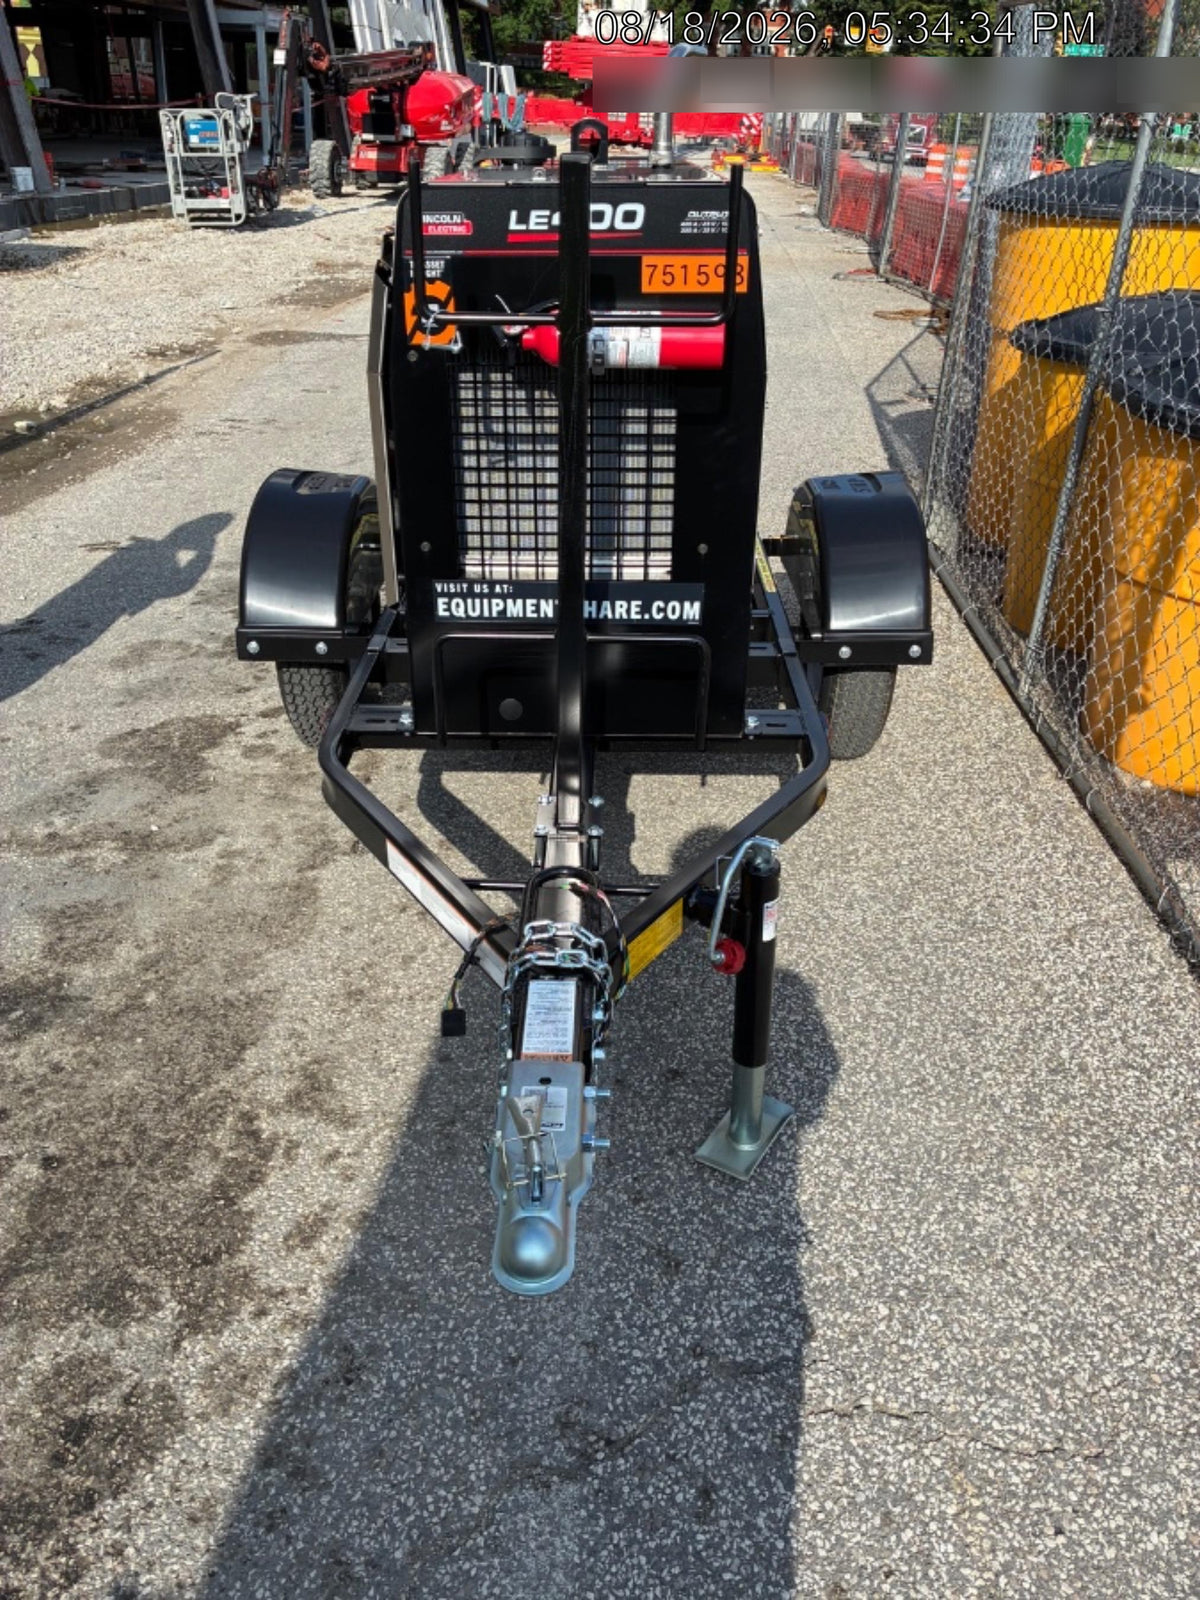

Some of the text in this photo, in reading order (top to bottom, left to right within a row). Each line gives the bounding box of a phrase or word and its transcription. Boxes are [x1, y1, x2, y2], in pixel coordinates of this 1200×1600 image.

[421, 214, 462, 224] INCOLN
[435, 582, 513, 594] VISIT US AT:
[436, 597, 700, 620] EQUIPMENHARE.COM
